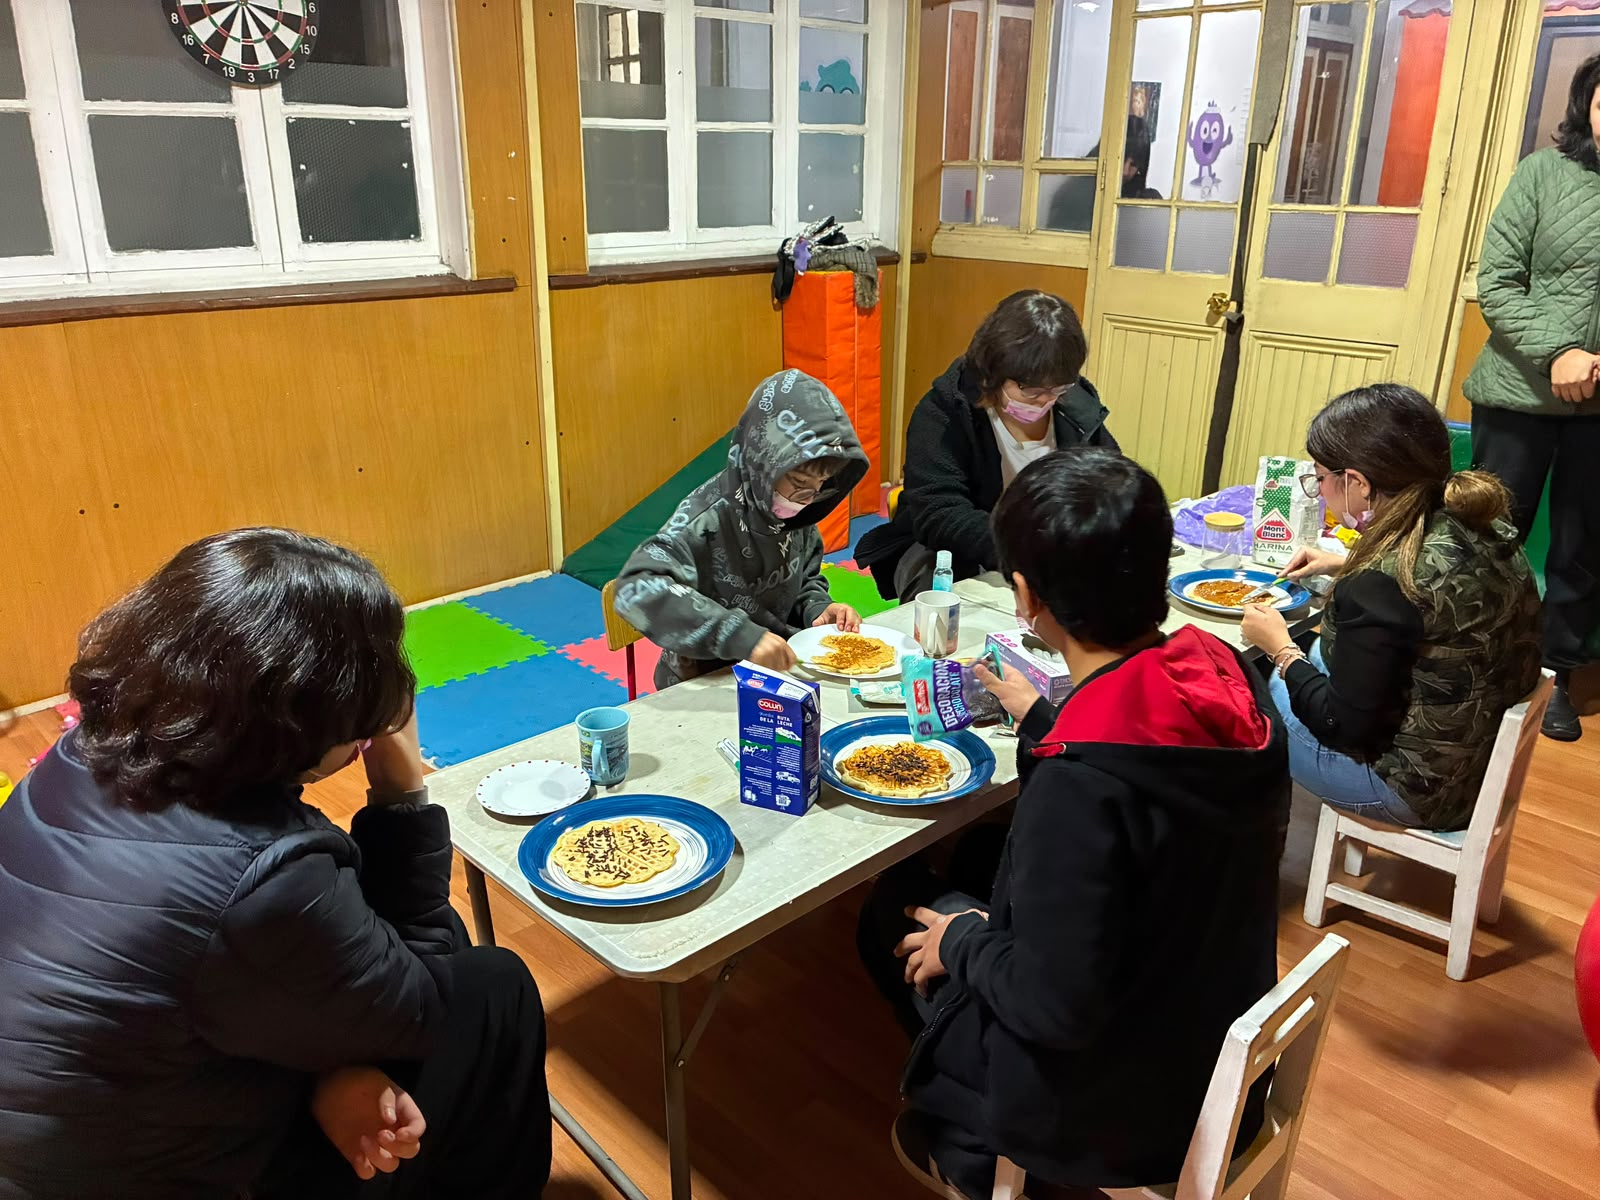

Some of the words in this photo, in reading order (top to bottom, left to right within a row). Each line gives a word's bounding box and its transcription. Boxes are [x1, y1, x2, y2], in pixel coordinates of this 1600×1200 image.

[308, 3, 316, 13] 6
[171, 12, 179, 24] 8
[306, 26, 318, 37] 10
[182, 34, 195, 46] 16
[299, 44, 311, 55] 15
[203, 54, 210, 65] 7
[288, 59, 296, 69] 2
[222, 66, 236, 78] 19
[248, 72, 255, 83] 3
[268, 69, 280, 80] 17
[1264, 525, 1286, 533] Mont
[1262, 531, 1286, 539] Blanc
[1253, 542, 1293, 551] HARINA
